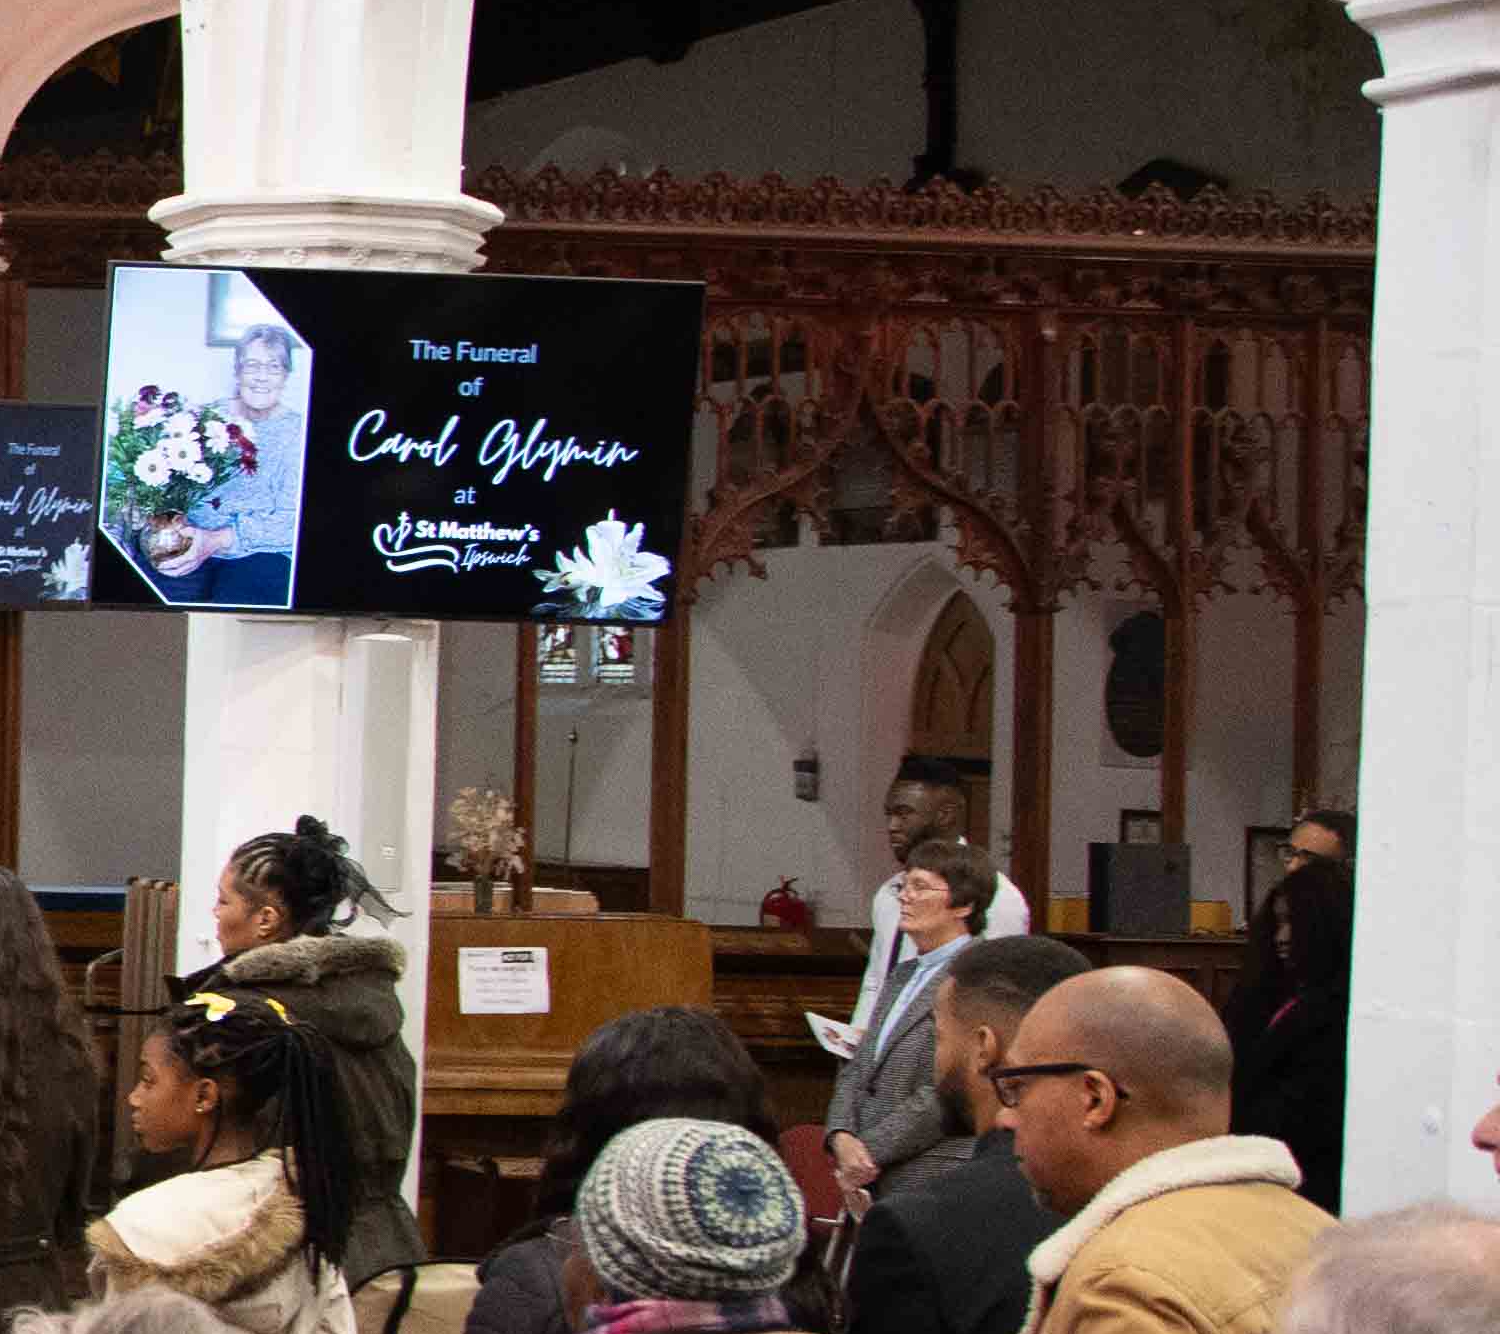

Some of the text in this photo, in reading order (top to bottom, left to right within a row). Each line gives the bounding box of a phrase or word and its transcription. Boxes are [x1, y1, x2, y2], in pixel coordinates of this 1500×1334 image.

[409, 339, 538, 364] The Funeral
[458, 377, 484, 396] of
[349, 409, 639, 485] Carol Glymin
[454, 486, 476, 504] at
[415, 520, 540, 542] St Matthew's
[460, 543, 532, 571] Ipswich
